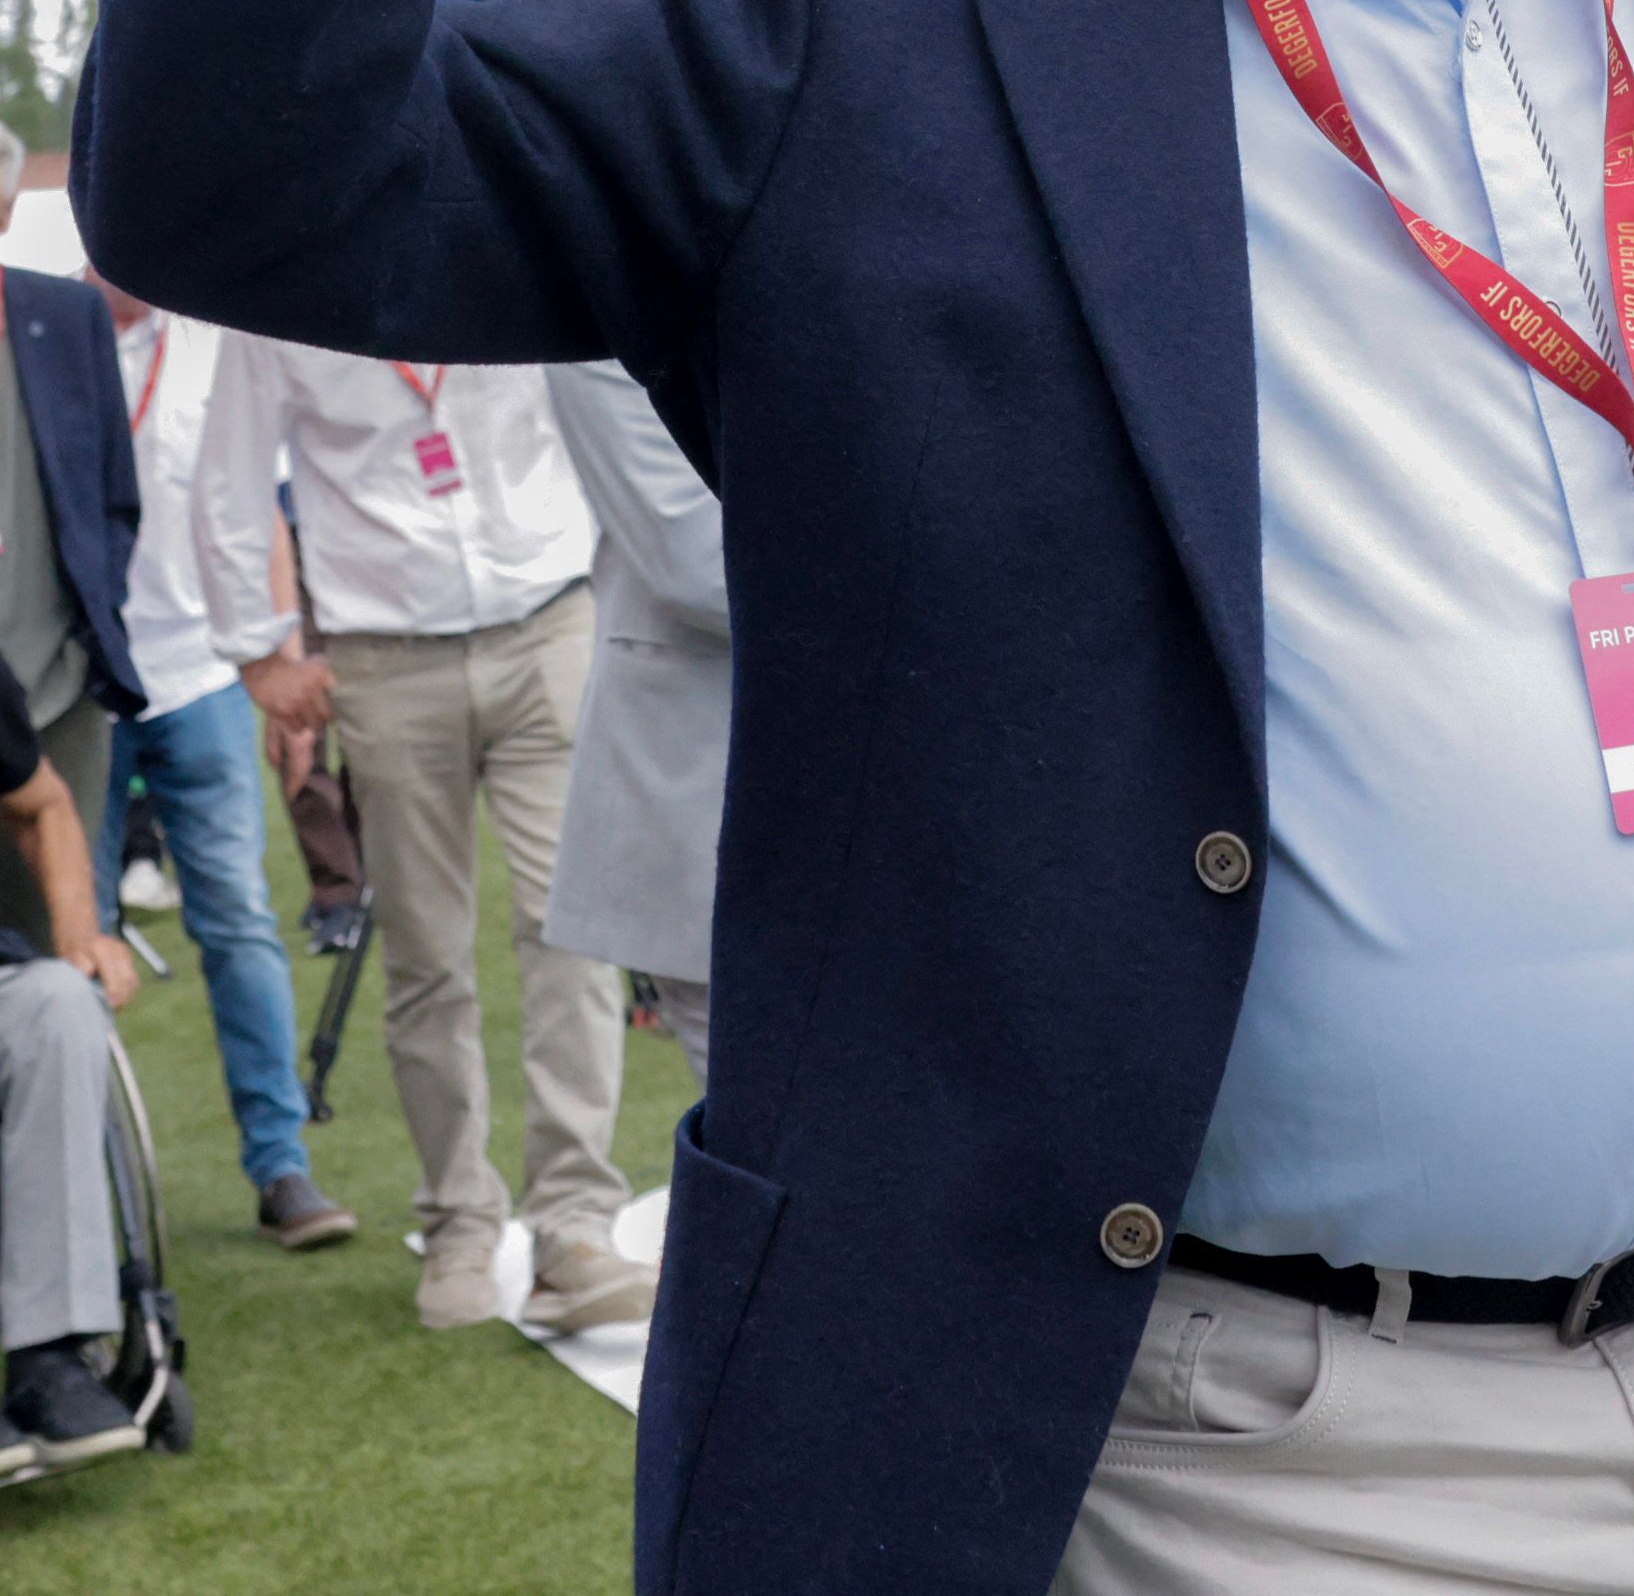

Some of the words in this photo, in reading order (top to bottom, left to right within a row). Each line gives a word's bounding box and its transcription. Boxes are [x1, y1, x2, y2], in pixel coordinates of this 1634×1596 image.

[1480, 281, 1508, 307] IF
[1499, 296, 1600, 393] DEGERFORS
[1589, 628, 1620, 650] FRI
